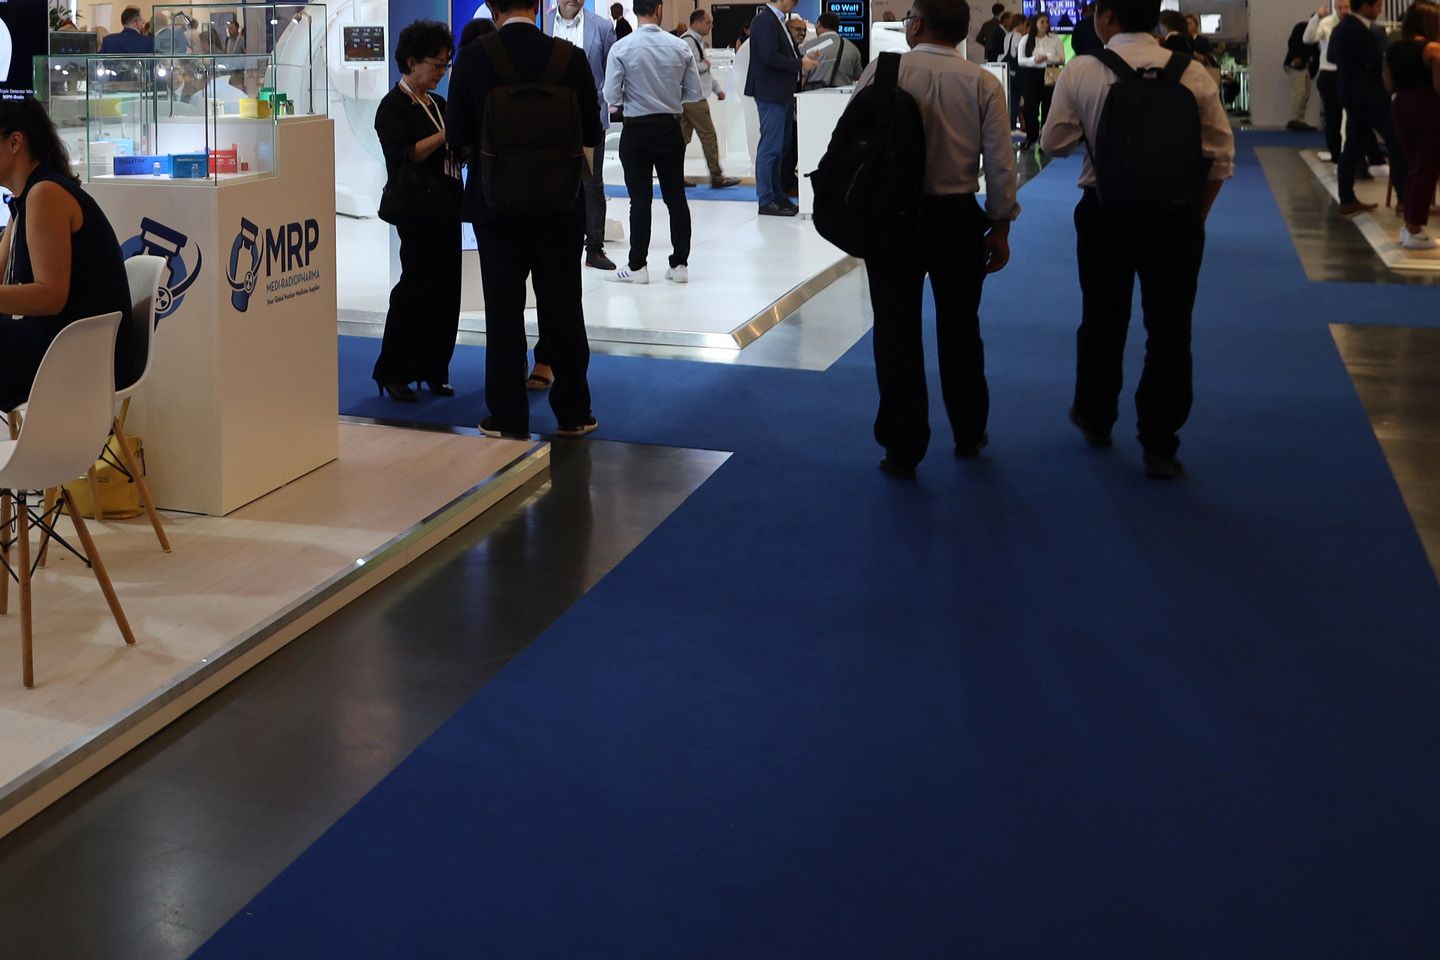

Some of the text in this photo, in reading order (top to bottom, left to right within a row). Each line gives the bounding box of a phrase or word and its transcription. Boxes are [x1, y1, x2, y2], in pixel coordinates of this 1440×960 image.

[841, 3, 859, 11] Watt
[265, 218, 320, 277] MRP
[266, 269, 320, 293] MEDI-RADIOPHARMA
